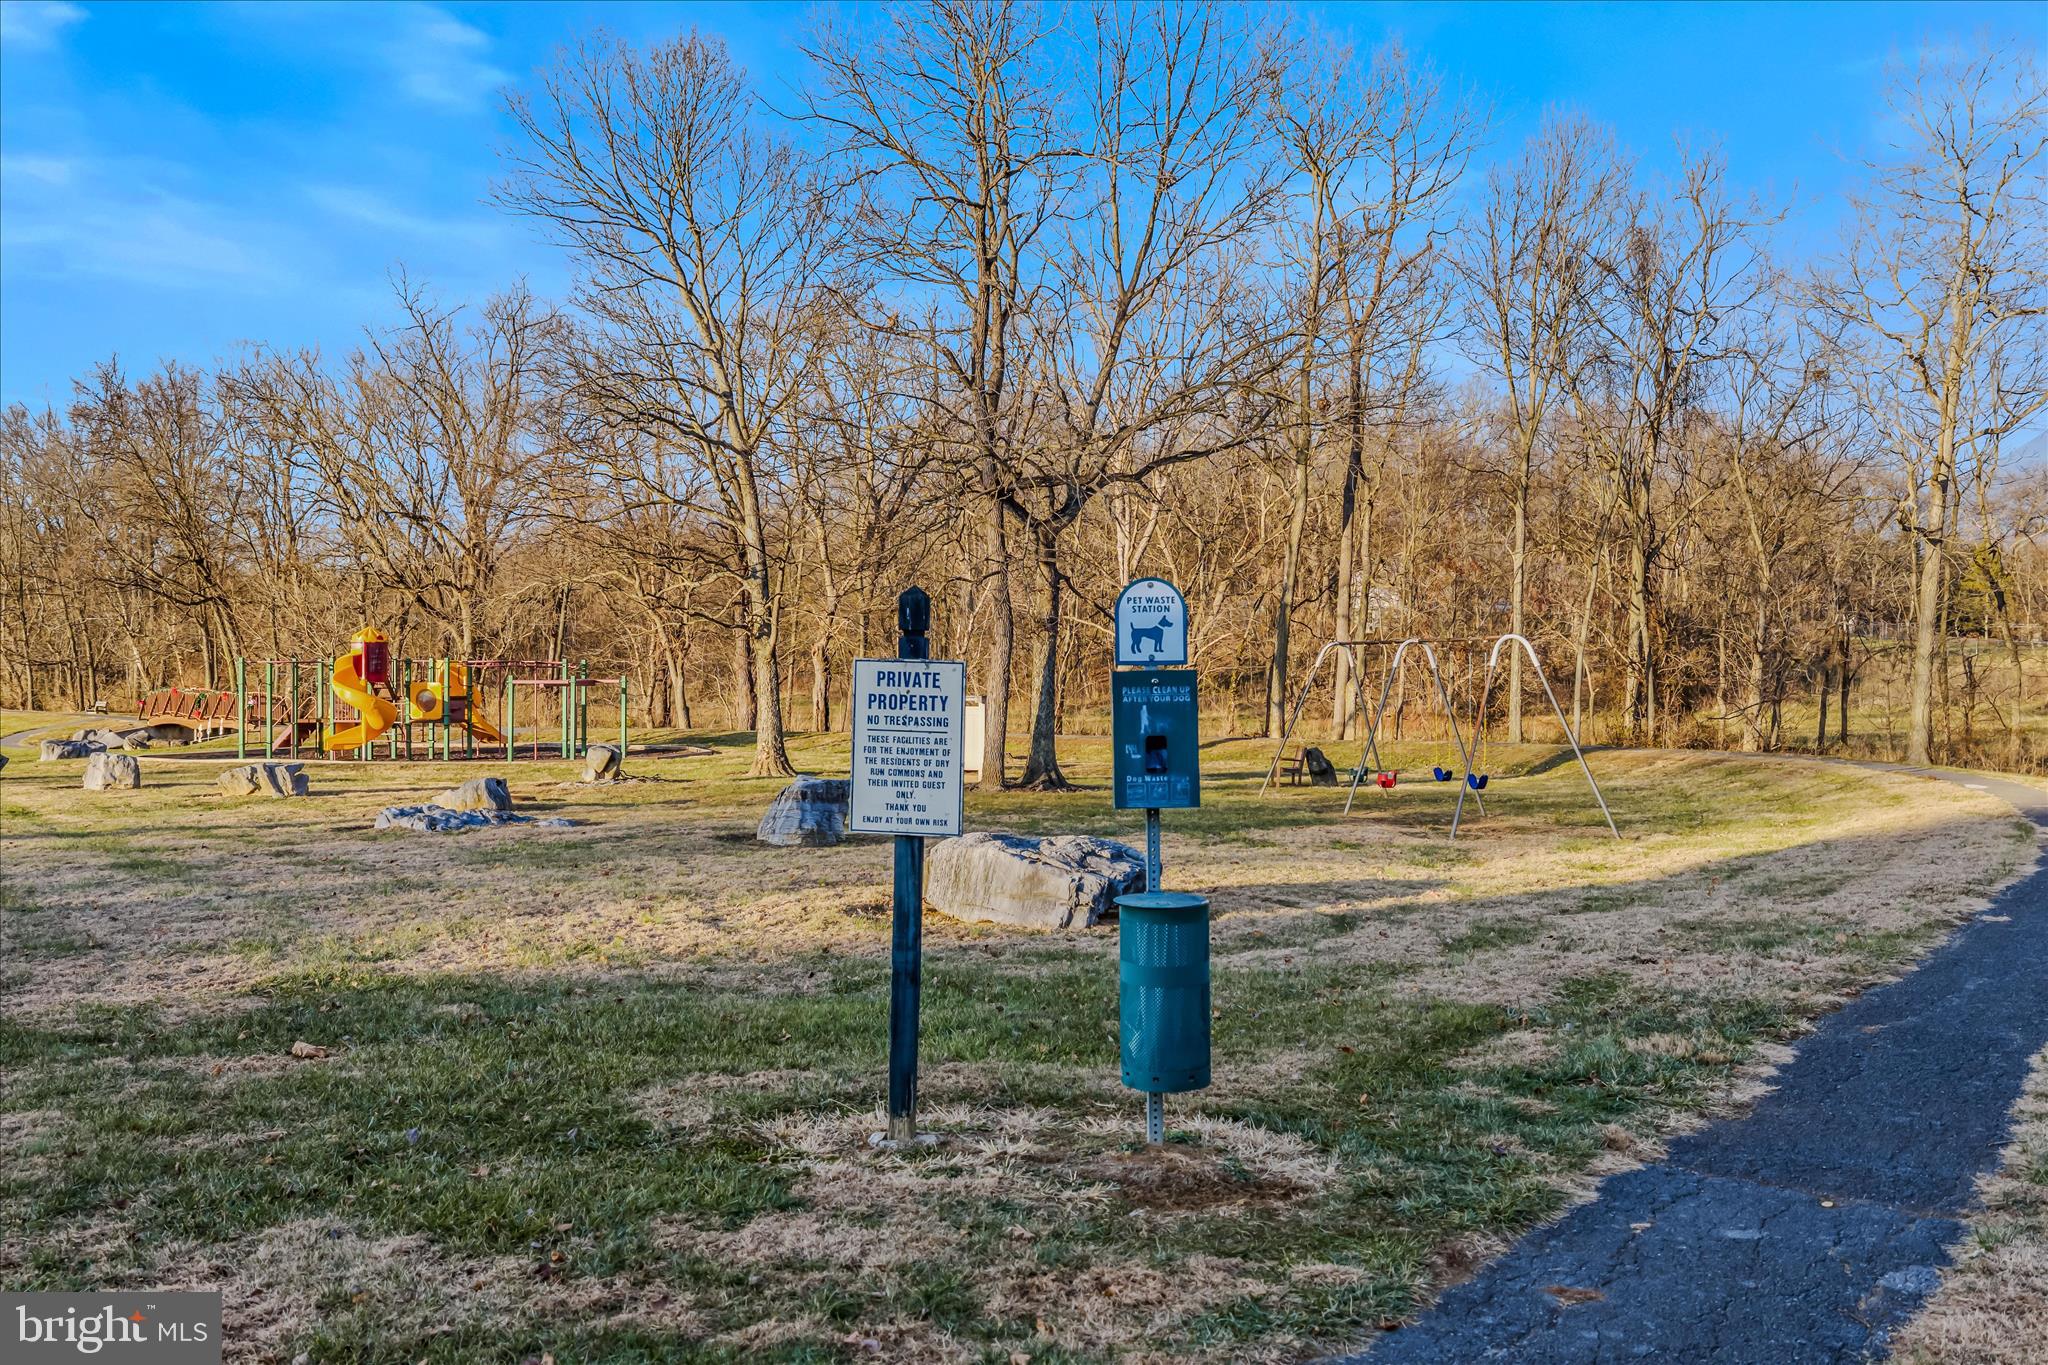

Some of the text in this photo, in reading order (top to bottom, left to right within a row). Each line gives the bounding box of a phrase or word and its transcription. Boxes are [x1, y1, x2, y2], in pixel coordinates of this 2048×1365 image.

[1132, 605, 1170, 613] STATION
[877, 671, 940, 688] PRIVATE
[1152, 686, 1177, 694] CLEAN
[868, 693, 948, 712] PROPERTY
[867, 715, 949, 727] NO TRESPASSING
[867, 735, 948, 745] THESE FACILITIES ARE
[863, 746, 877, 754] FOR
[896, 747, 939, 756] ENJOYMENT
[942, 749, 951, 757] OF
[864, 757, 878, 765] THE
[880, 757, 921, 766] RESIDENTS
[870, 768, 943, 778] RUN COMMONS AND
[867, 779, 946, 789] THEIR INVITED GUEST
[896, 790, 916, 799] ONLY.
[885, 803, 927, 812] THANK YOU
[862, 816, 948, 827] ENJOY AT YOUR OWN RISK
